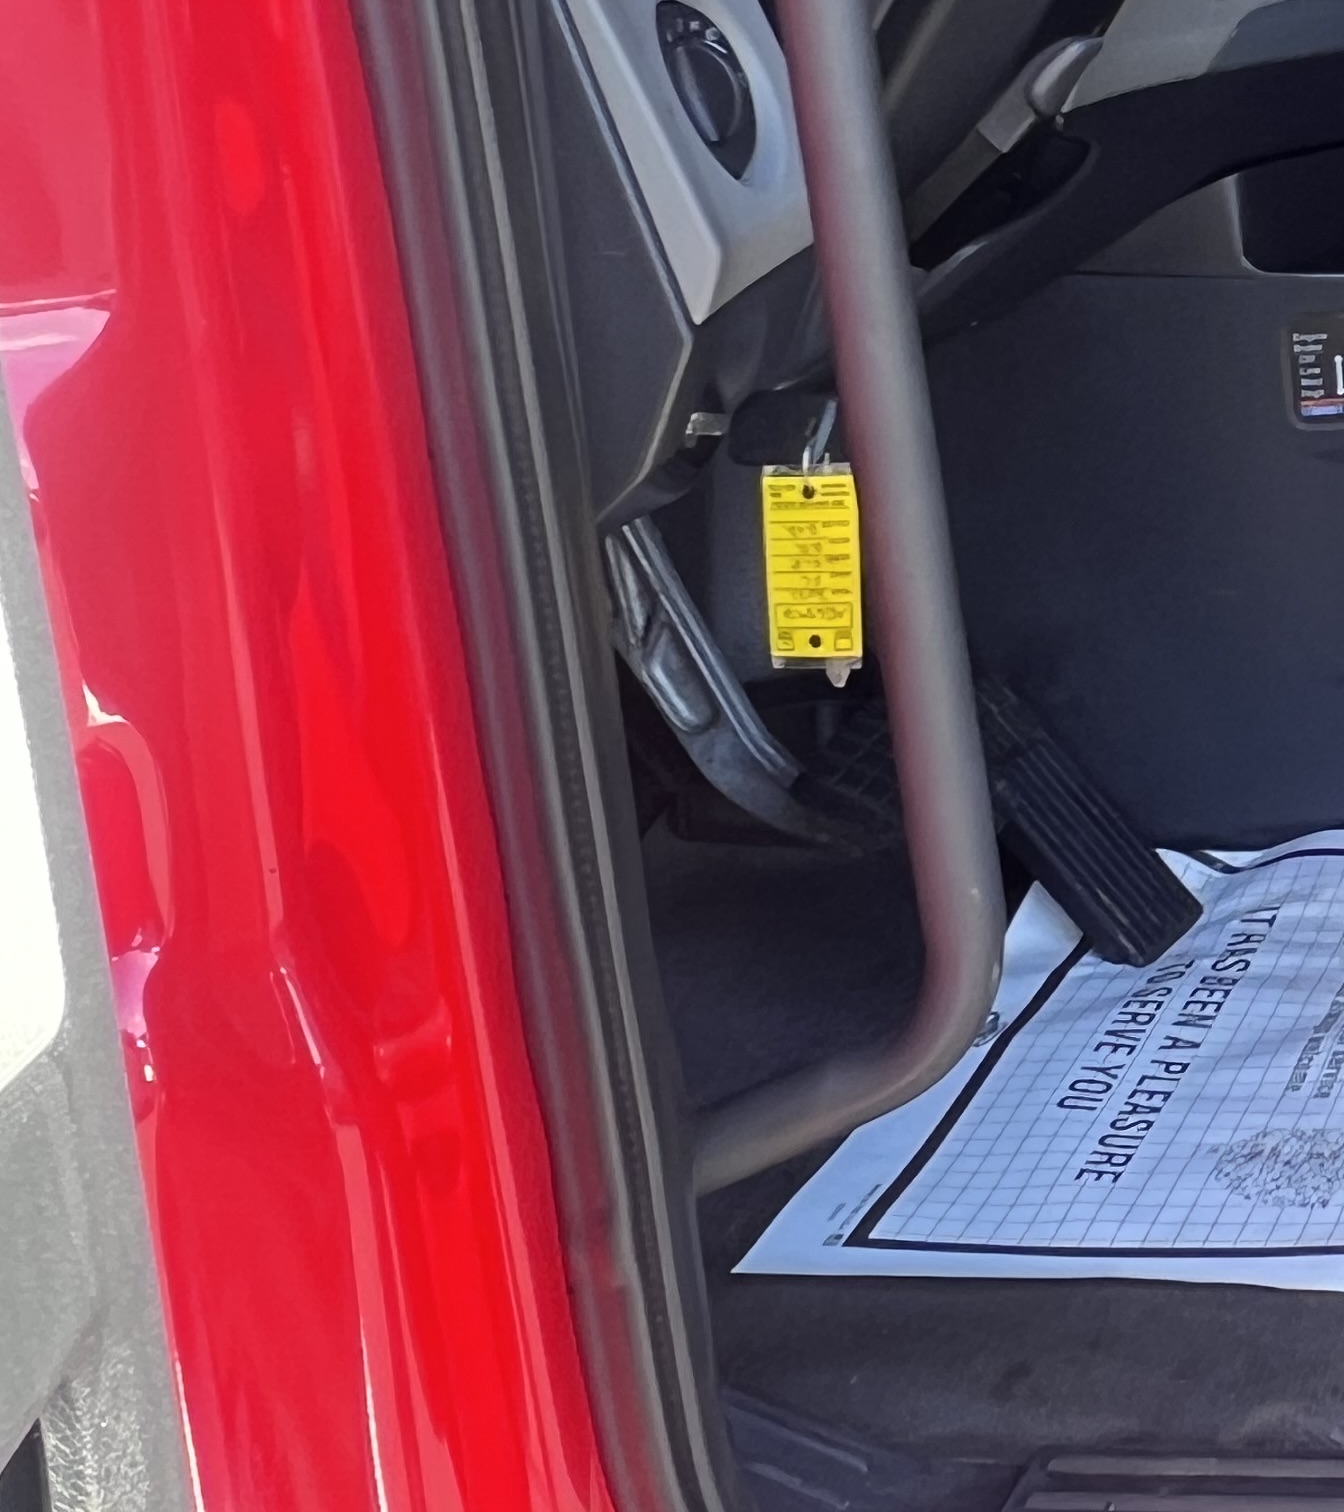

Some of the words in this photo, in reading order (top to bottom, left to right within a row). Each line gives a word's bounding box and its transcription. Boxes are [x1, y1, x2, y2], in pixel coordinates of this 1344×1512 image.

[1239, 906, 1281, 928] IT
[1146, 960, 1196, 985] TO
[1210, 932, 1268, 973] HAS
[1092, 987, 1173, 1056] SERVE
[1171, 975, 1244, 1029] BEEN
[1157, 1035, 1203, 1050] A
[1055, 1063, 1127, 1112] YOU
[1074, 1059, 1191, 1184] PLEASURE
